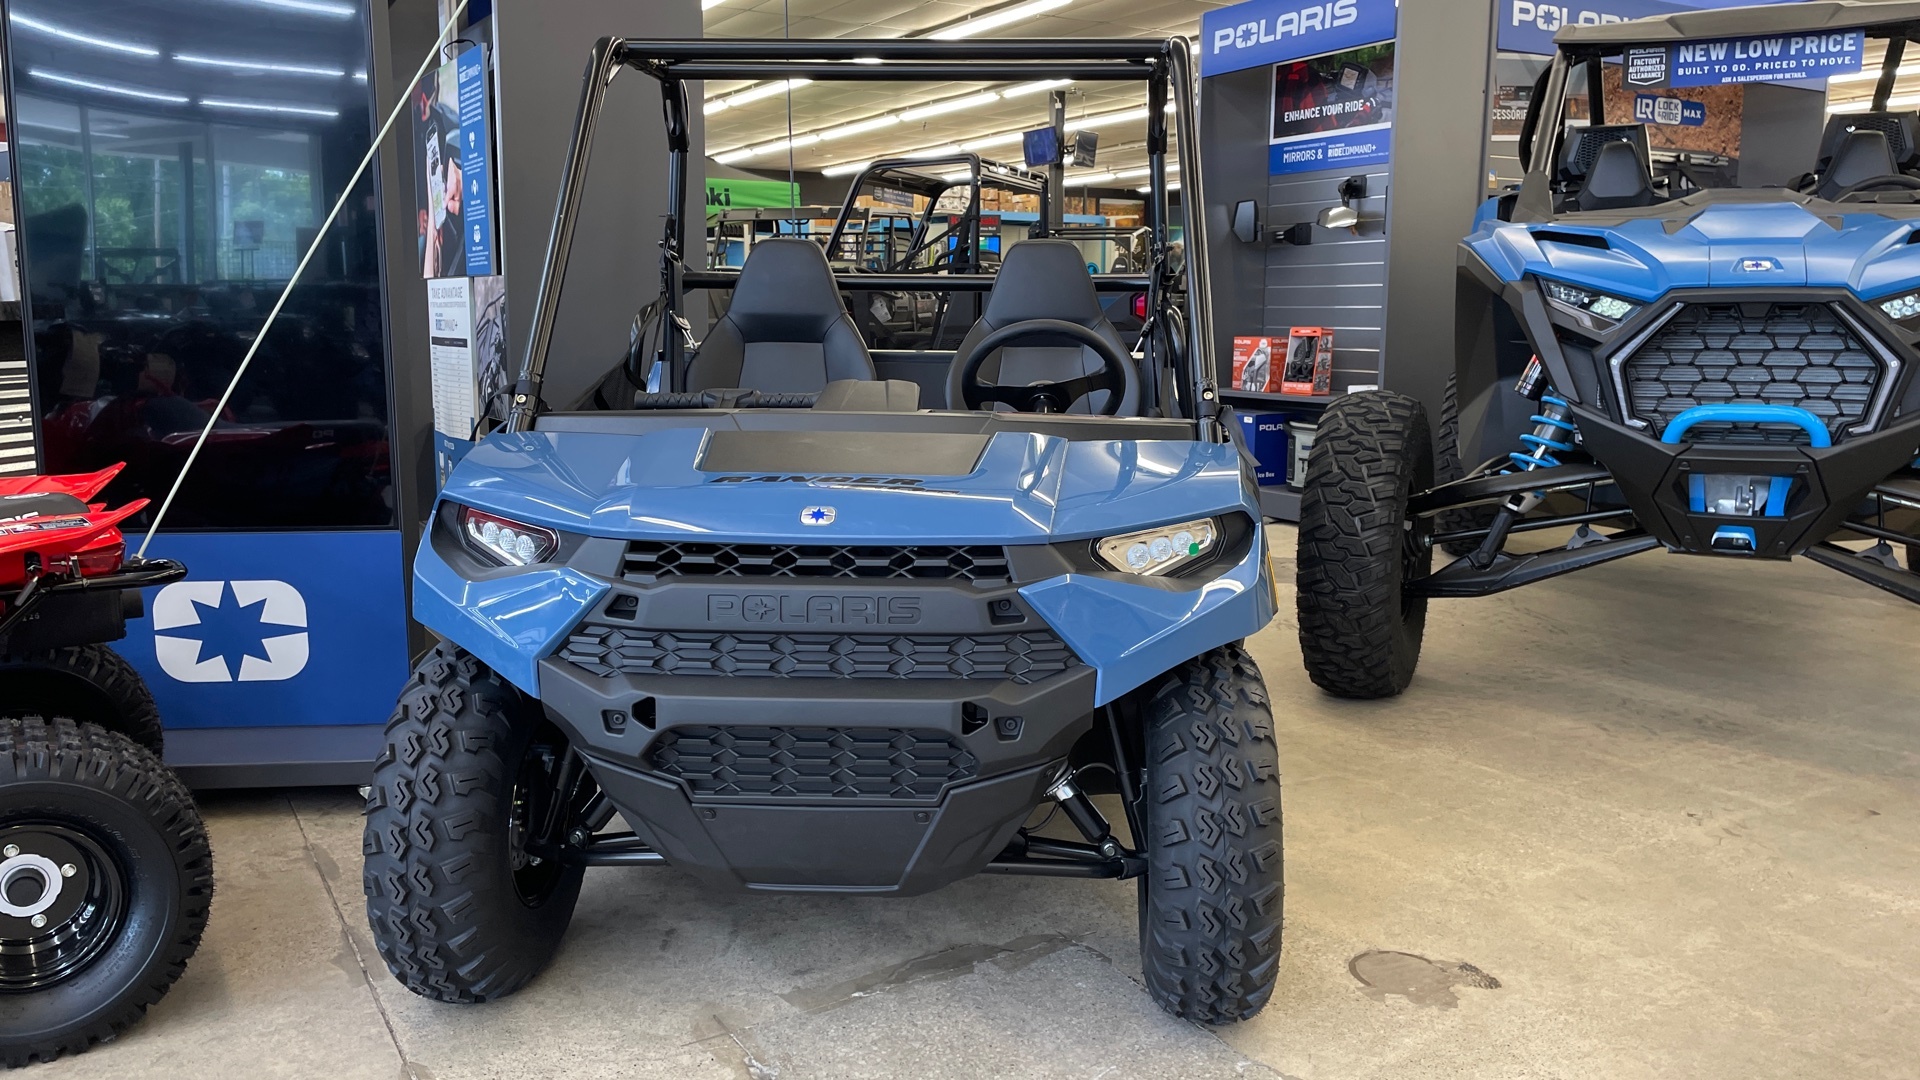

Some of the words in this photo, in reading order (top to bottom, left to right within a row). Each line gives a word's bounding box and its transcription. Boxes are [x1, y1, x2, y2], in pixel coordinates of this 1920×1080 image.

[1213, 0, 1358, 55] POLARIS
[1679, 42, 1728, 63] NEW
[1734, 38, 1783, 59] LOW
[1789, 32, 1857, 56] PRICE
[1628, 65, 1666, 73] AUTHORIZED
[1633, 57, 1661, 66] FACTORY
[1677, 65, 1710, 76] BUILT
[1714, 64, 1728, 73] TO
[1732, 63, 1750, 72] GO.
[1755, 60, 1797, 71] PRICED
[1801, 59, 1816, 67] TO
[1820, 56, 1855, 66] MOVE.
[1630, 71, 1662, 80] CLEARANCE
[1284, 107, 1321, 123] ENHANCE
[1322, 103, 1343, 117] YOUR
[1344, 99, 1365, 113] RIDE
[1657, 100, 1680, 112] LOCK
[1683, 108, 1702, 119] MAX
[1283, 150, 1316, 164] MIRRORS
[1317, 148, 1323, 160] &
[1327, 143, 1377, 158] RIDECOMMAND+
[709, 475, 924, 486] RANGER
[707, 593, 922, 625] POLARIS
